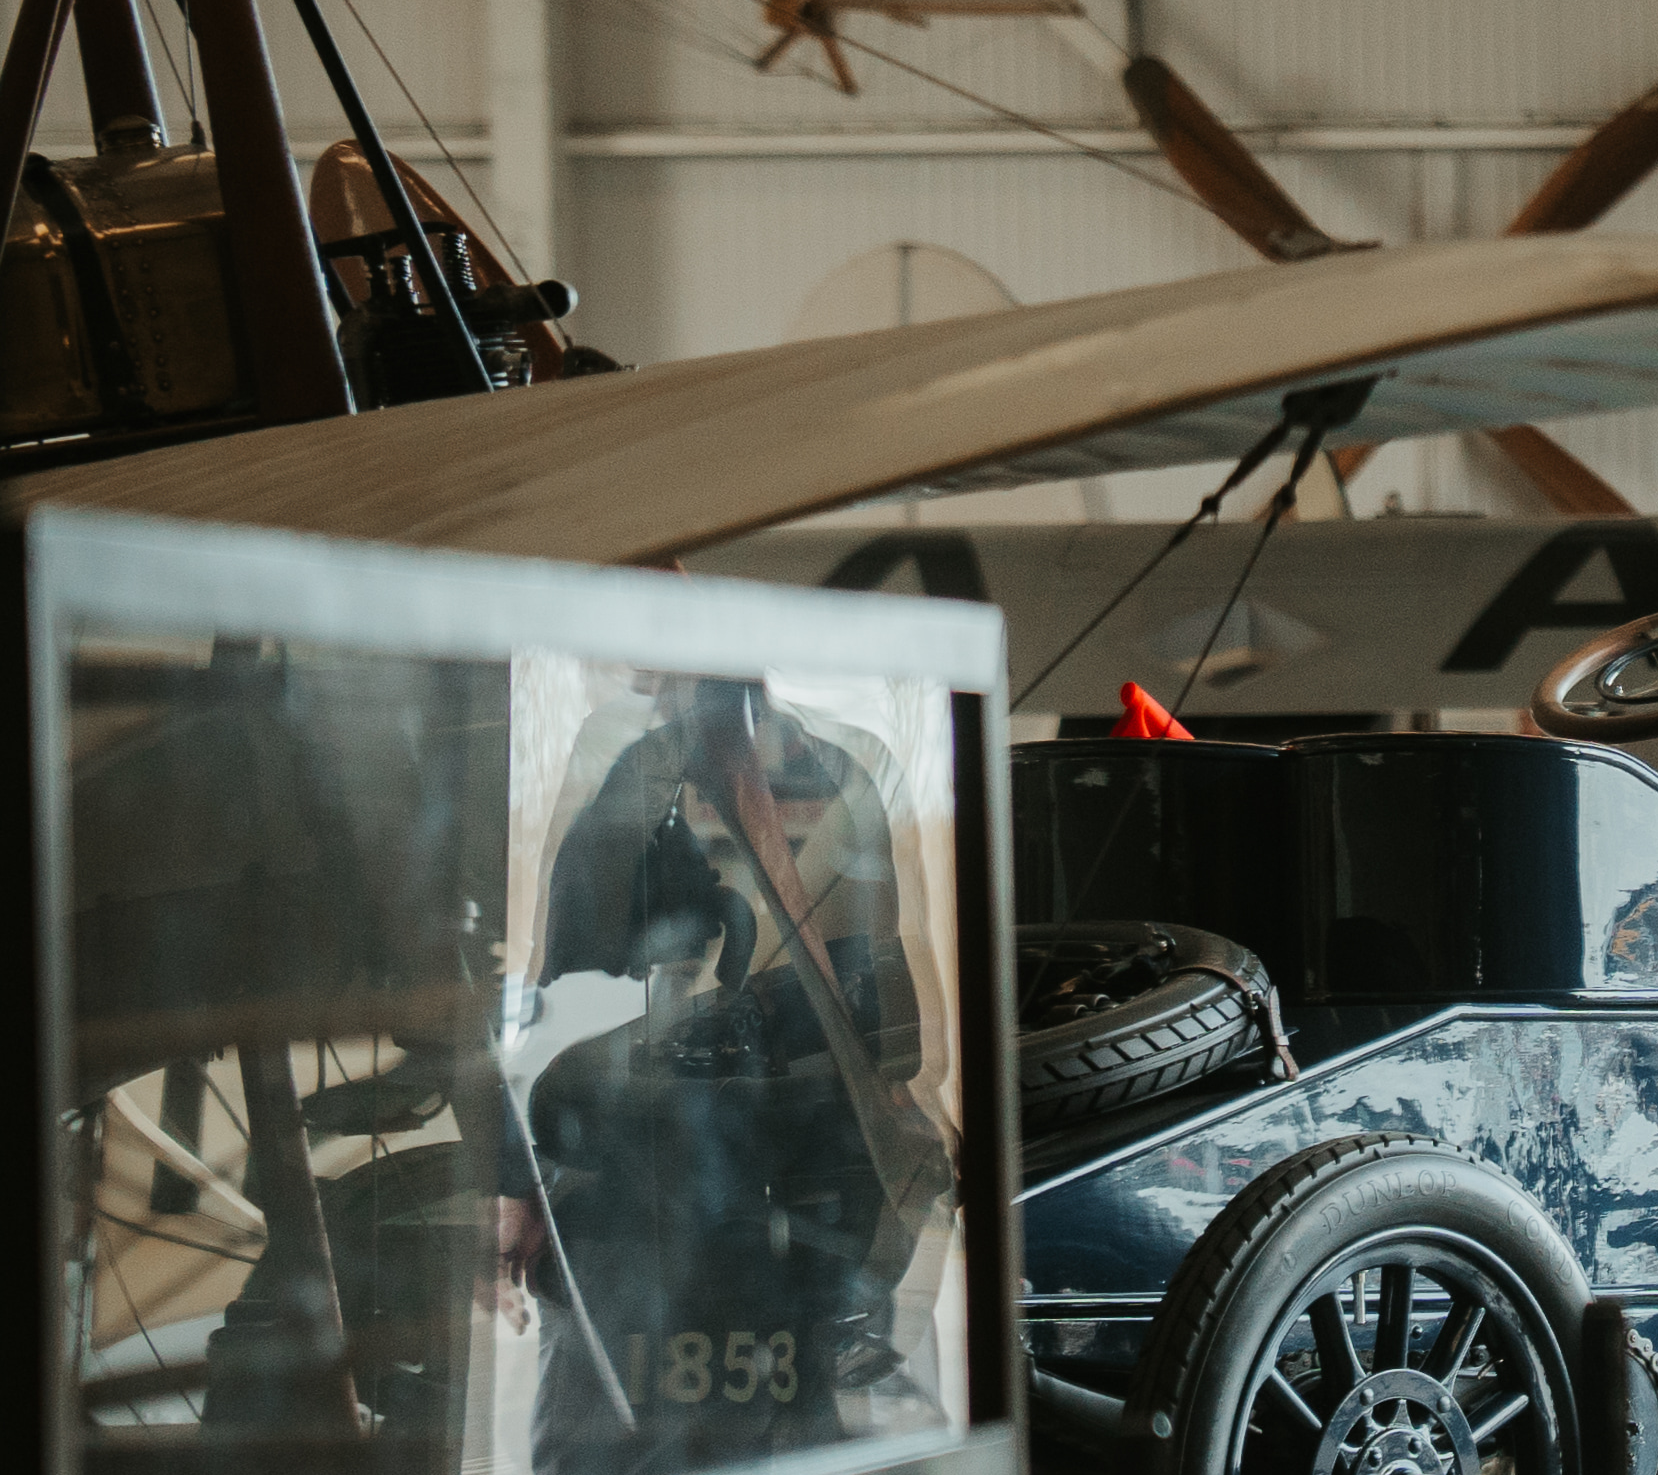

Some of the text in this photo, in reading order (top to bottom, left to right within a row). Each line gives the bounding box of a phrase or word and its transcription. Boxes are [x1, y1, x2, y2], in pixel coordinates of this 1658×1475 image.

[1318, 1169, 1574, 1285] DUNLOP CORD
[627, 1330, 799, 1405] 1853
